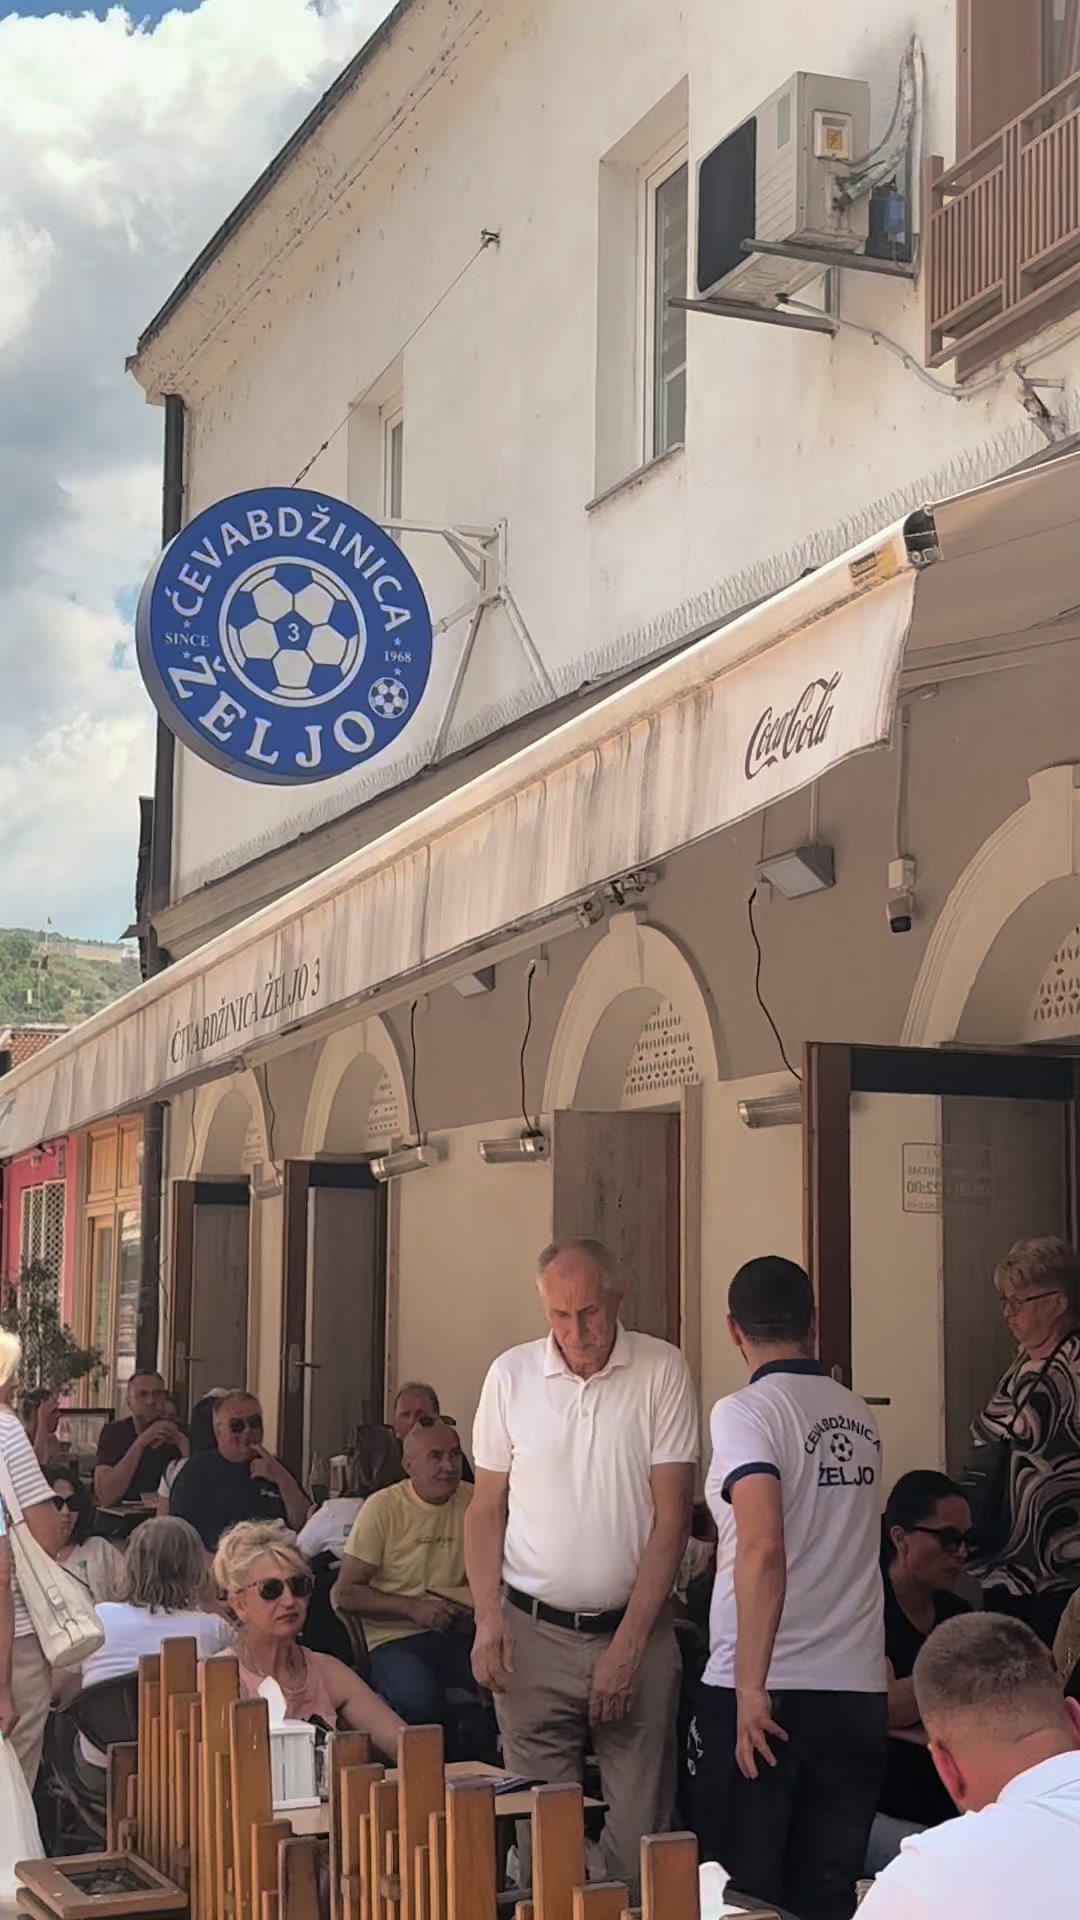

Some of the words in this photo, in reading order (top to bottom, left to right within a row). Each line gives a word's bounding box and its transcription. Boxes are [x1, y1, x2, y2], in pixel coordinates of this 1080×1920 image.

[165, 503, 412, 632] ĆEVABDŽINICA
[164, 631, 210, 648] SINCE
[287, 623, 300, 641] 3
[384, 650, 412, 663] 1968
[168, 655, 375, 768] ŽELJO
[311, 957, 320, 996] 3
